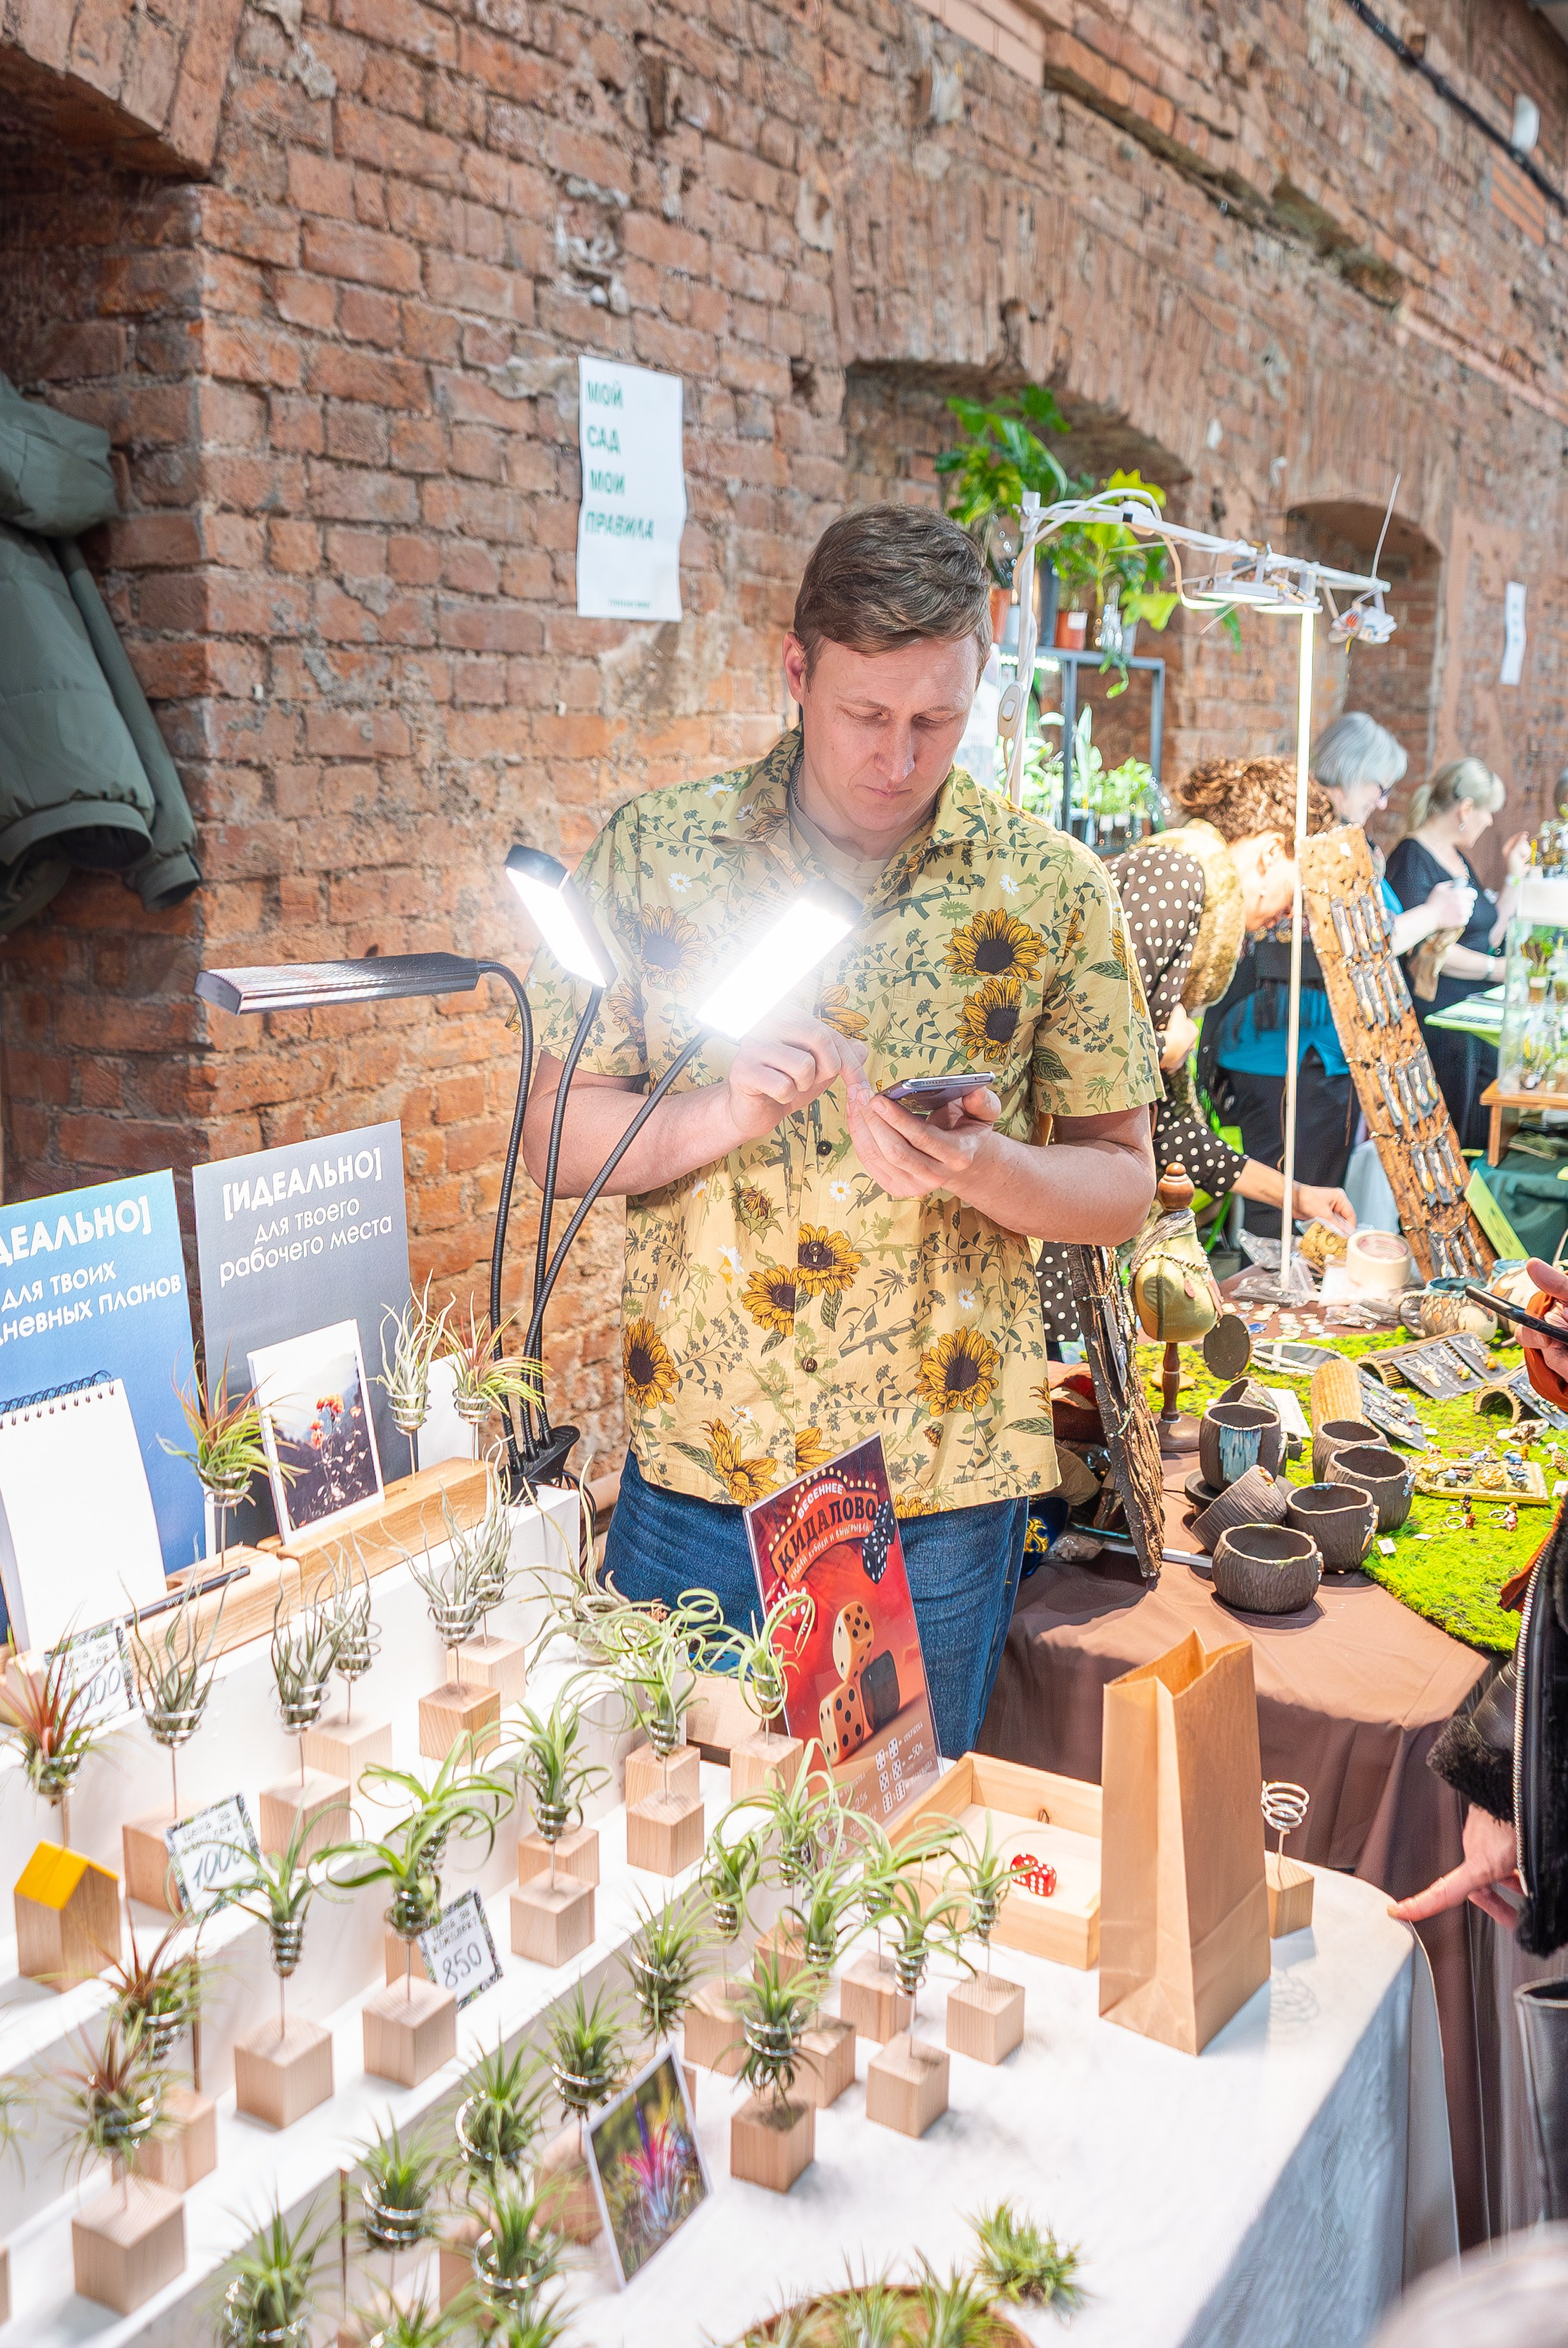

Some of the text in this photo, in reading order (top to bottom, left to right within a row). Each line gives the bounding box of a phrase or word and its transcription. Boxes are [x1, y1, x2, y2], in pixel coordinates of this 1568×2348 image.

[586, 379, 623, 409] МОЙ
[587, 425, 620, 455] САД
[590, 468, 625, 496] МОИ
[585, 510, 654, 539] ПРАВИЛА
[223, 1147, 382, 1221] [ИДЕАЛЬНО]
[254, 1198, 360, 1246] для твоего
[220, 1215, 392, 1288] рабочего места
[0, 1274, 182, 1347] невных планов
[1, 1261, 117, 1312] для твоих
[797, 1482, 844, 1520] ВЕСЕННЕЕ
[778, 1496, 877, 1574] КИДАЛОВО
[193, 1835, 244, 1889] 1000
[443, 1941, 482, 1990] 850
